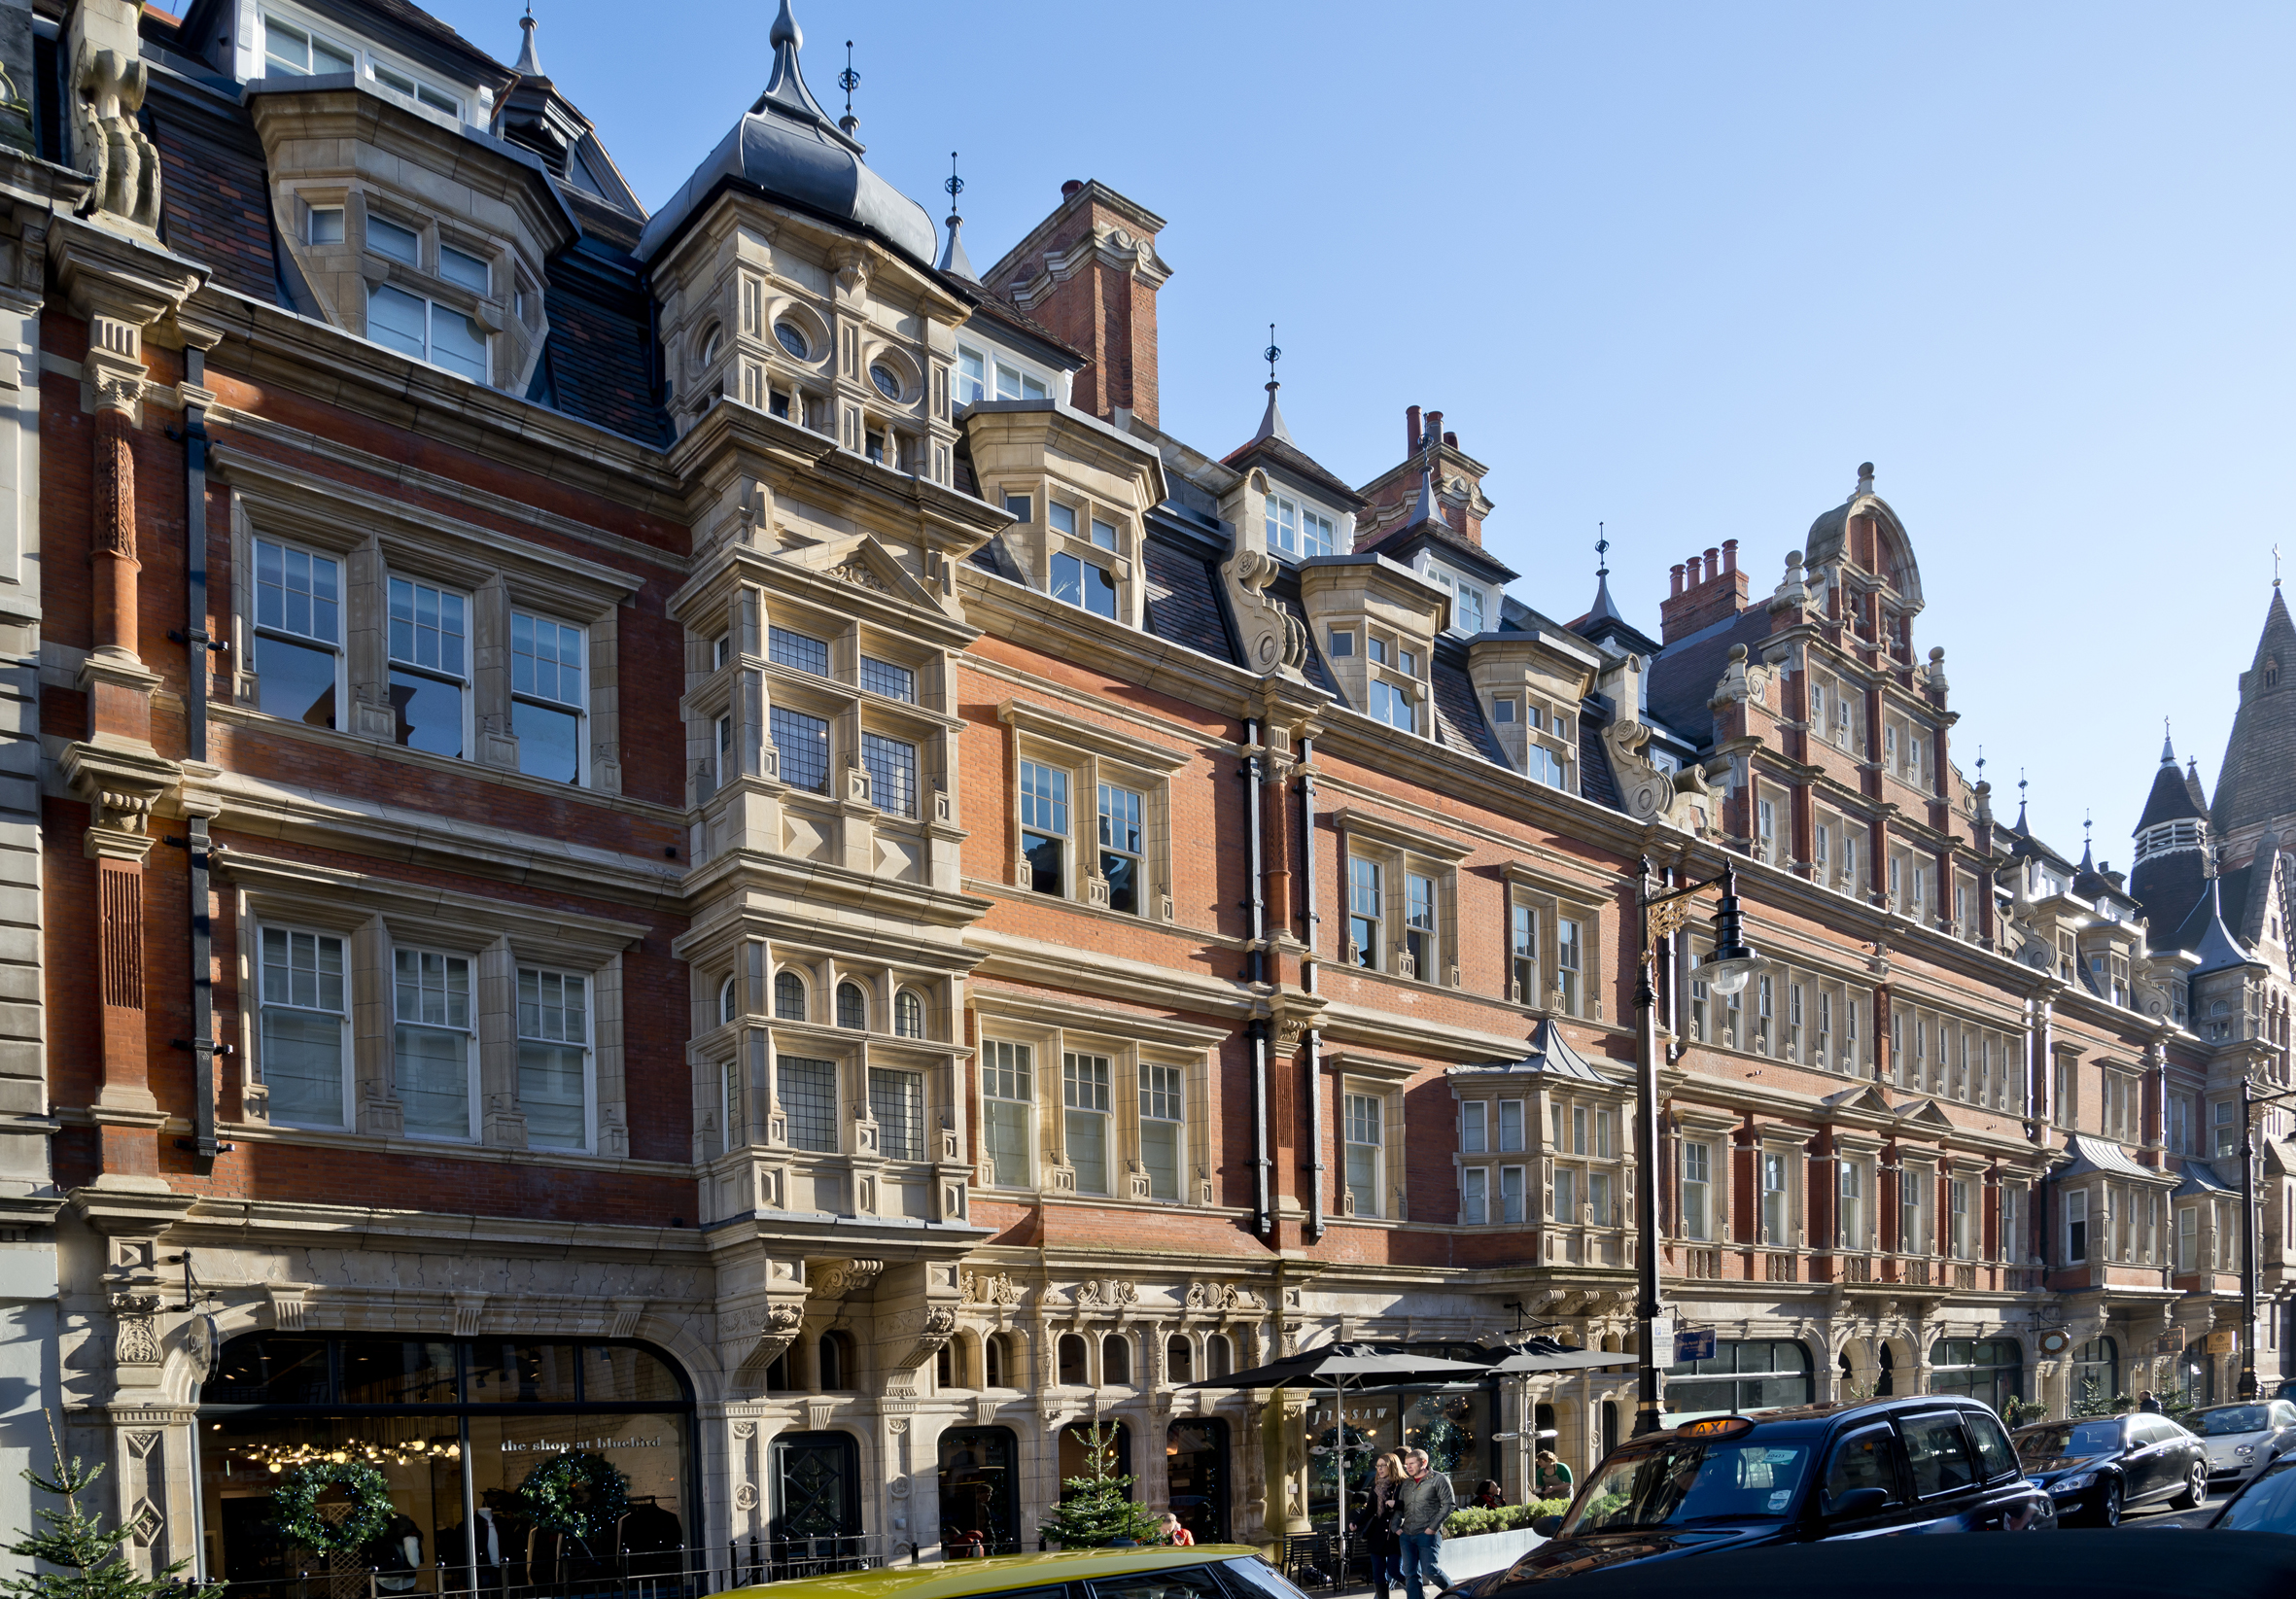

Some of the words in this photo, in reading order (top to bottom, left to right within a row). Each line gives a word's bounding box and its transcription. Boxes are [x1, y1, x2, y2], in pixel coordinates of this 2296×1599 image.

[1687, 1421, 1729, 1436] TAXI
[501, 1440, 527, 1451] the
[532, 1439, 571, 1453] shop
[575, 1440, 591, 1449] at
[597, 1436, 661, 1448] bluebird
